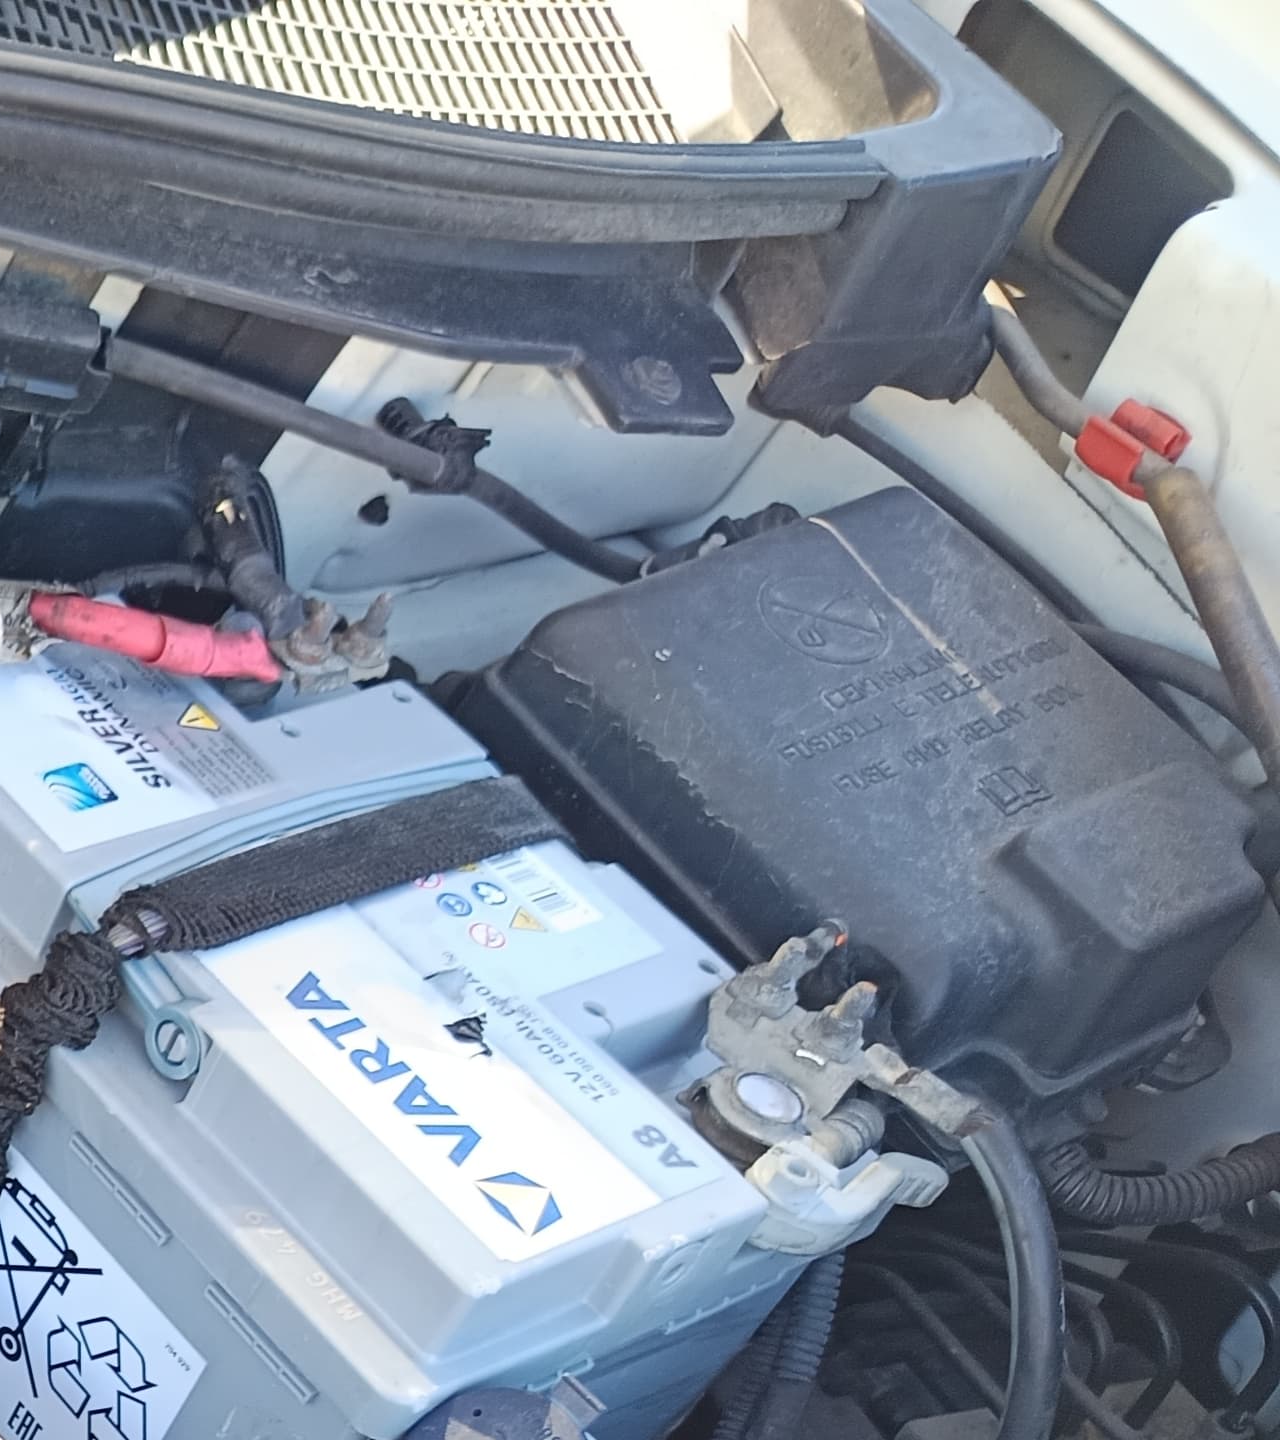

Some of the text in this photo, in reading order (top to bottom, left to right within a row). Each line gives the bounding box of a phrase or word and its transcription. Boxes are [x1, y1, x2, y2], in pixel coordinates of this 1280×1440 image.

[63, 666, 159, 754] DYNAMIC
[77, 709, 172, 789] SILVER
[833, 684, 1084, 793] FUSE AND RELAY BOX
[286, 971, 481, 1167] VARTA
[631, 1124, 699, 1168] A8
